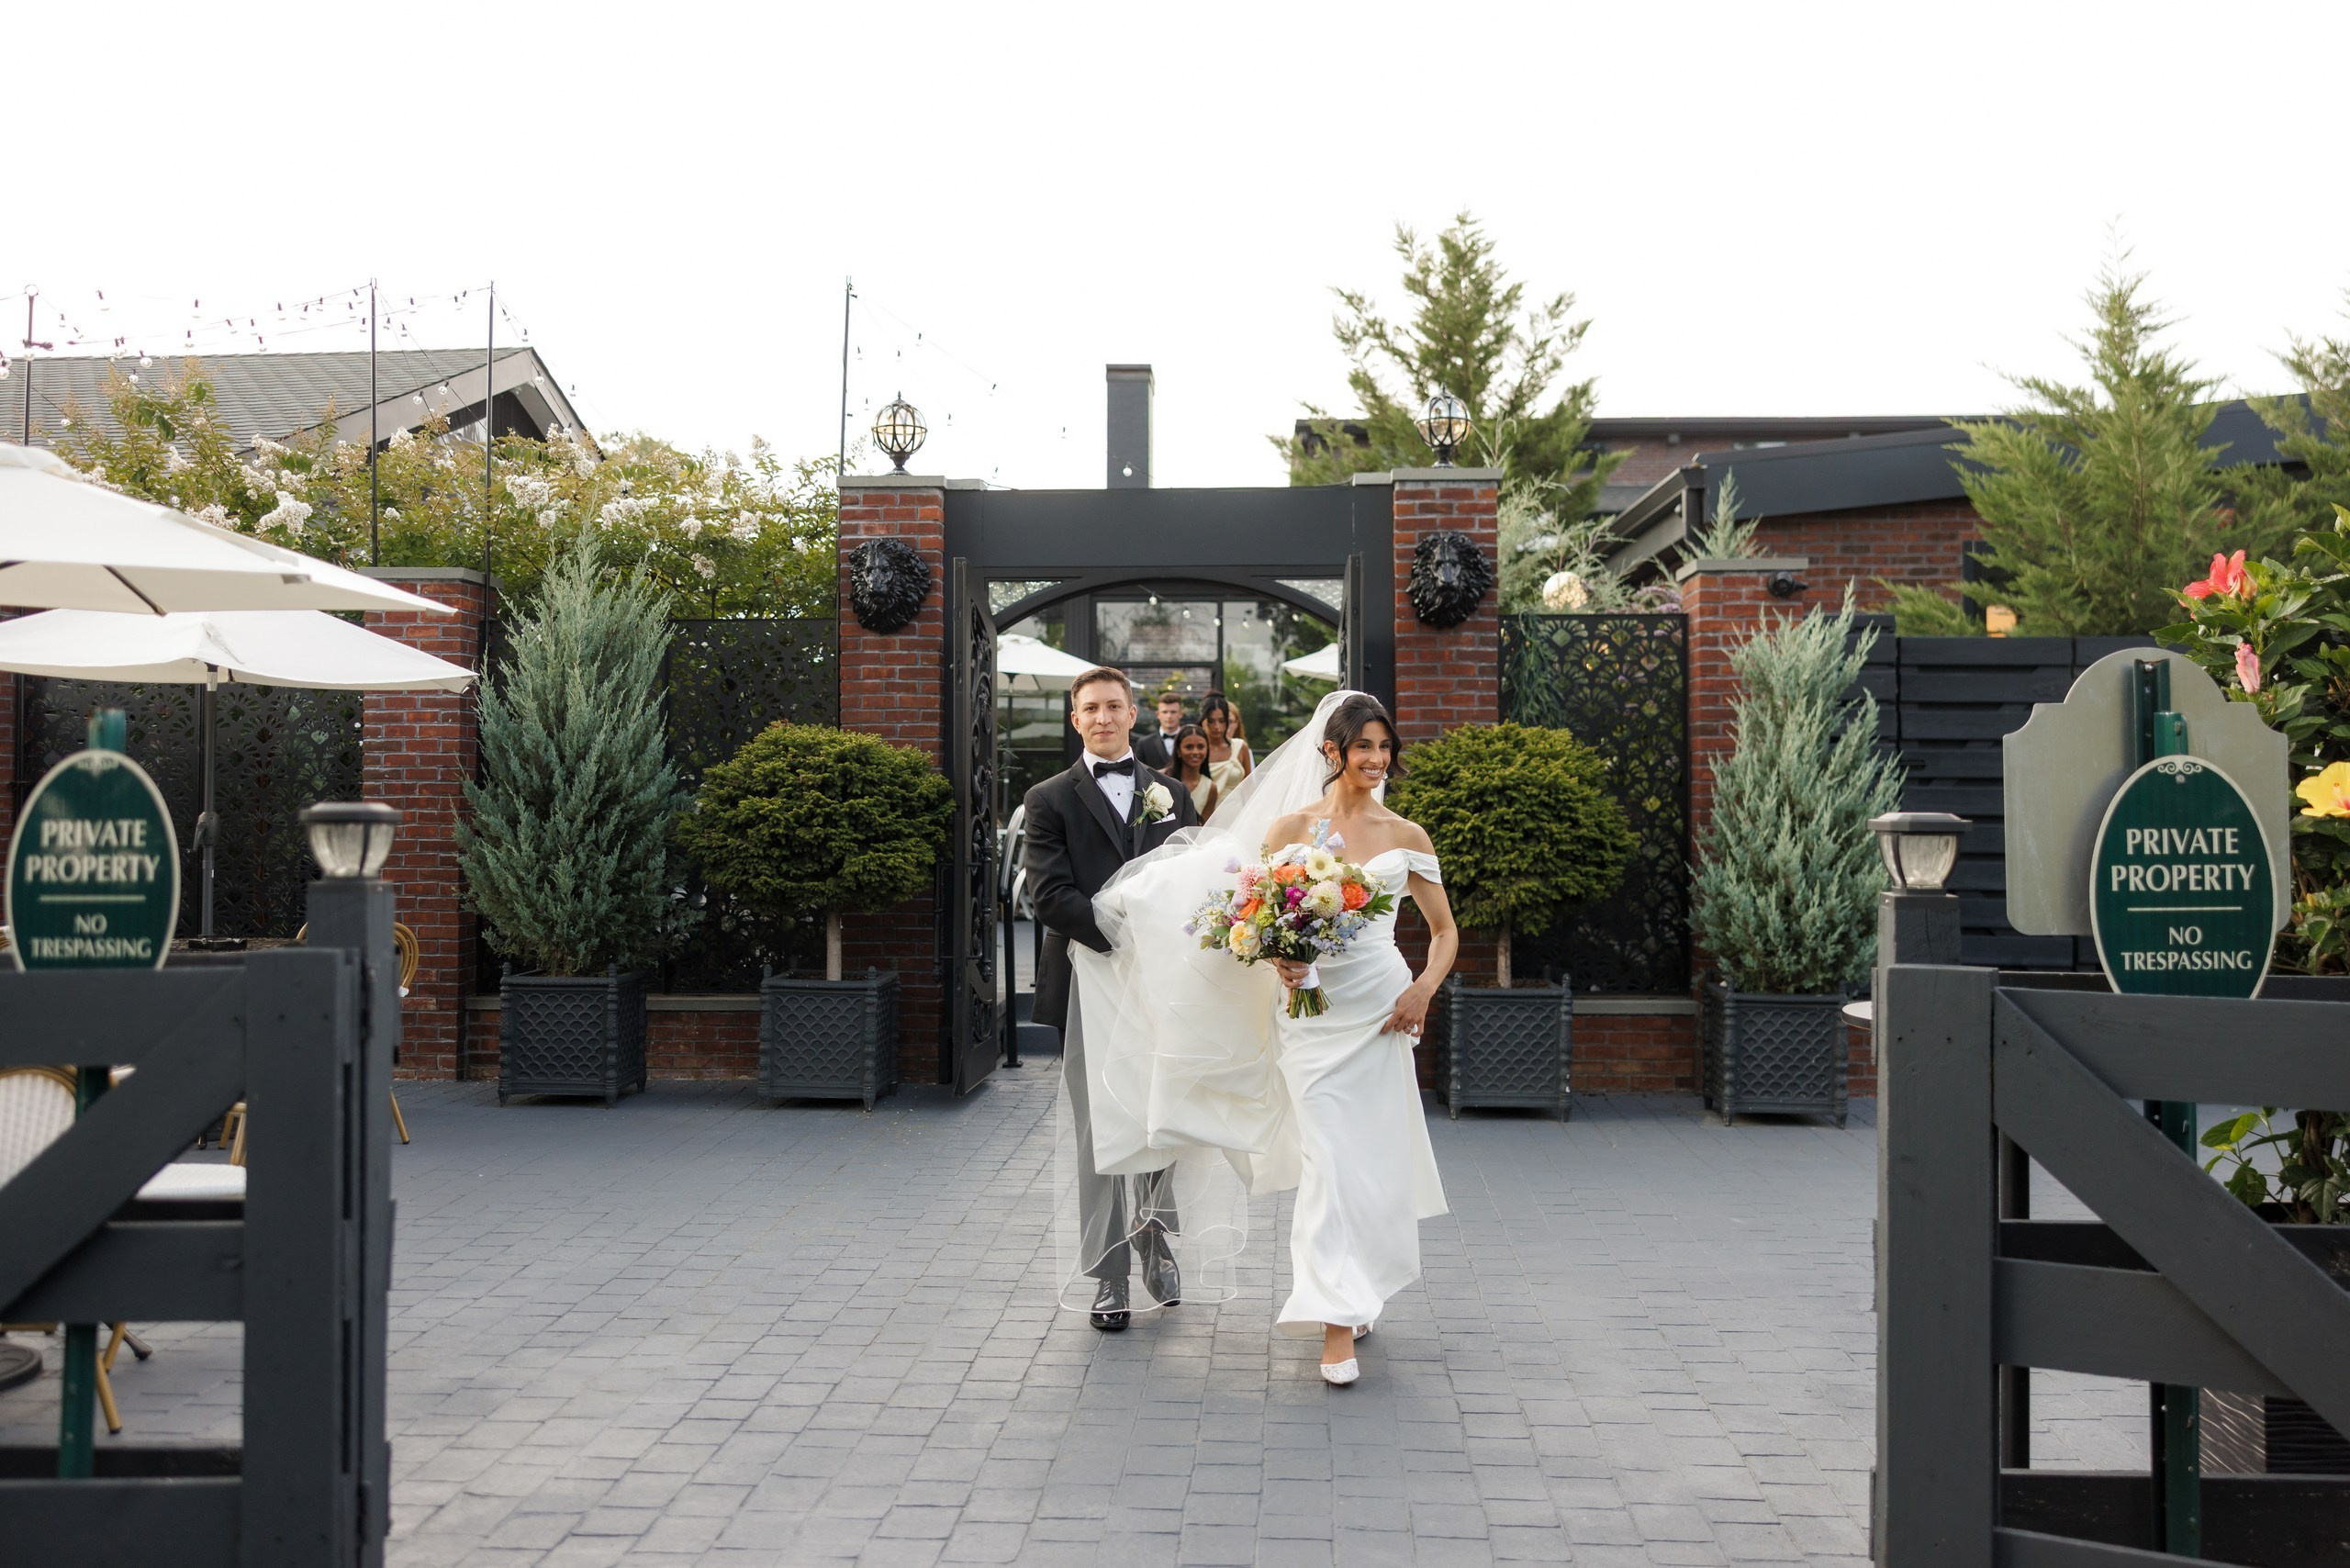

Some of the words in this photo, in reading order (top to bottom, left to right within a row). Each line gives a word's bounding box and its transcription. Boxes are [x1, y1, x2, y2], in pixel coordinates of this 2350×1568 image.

[40, 818, 148, 848] PRIVATE
[2126, 827, 2240, 856] PRIVATE
[25, 852, 160, 883] PROPERTY
[2110, 863, 2255, 892] PROPERTY
[73, 913, 107, 934] NO
[2168, 925, 2203, 946] NO
[30, 937, 151, 959] TRESPASSING
[2121, 950, 2254, 971] TRESPASSING
